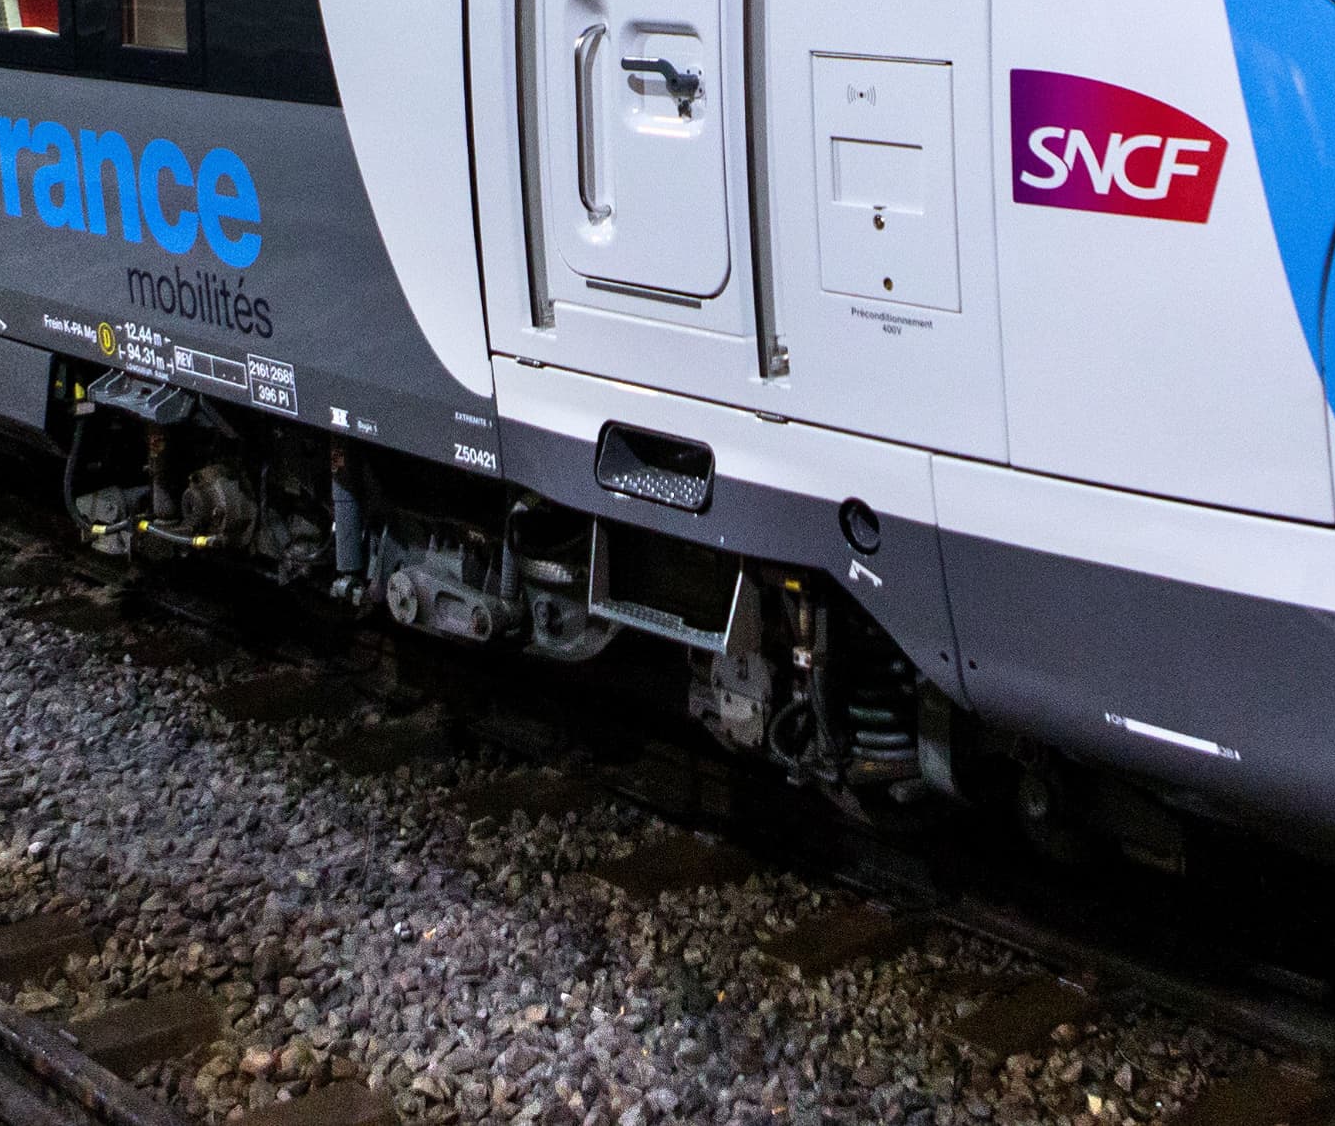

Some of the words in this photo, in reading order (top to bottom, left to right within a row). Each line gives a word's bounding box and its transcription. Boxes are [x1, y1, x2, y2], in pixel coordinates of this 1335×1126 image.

[1019, 125, 1211, 201] SNCF
[127, 266, 274, 339] mobilités
[43, 314, 63, 335] Frein
[851, 307, 933, 329] Préconditionnement
[153, 333, 163, 347] m
[127, 343, 156, 366] 94.31
[156, 356, 165, 370] m
[249, 361, 270, 378] 216t
[270, 366, 294, 384] 268t
[258, 385, 277, 403] 396
[454, 443, 497, 469] Z50421
